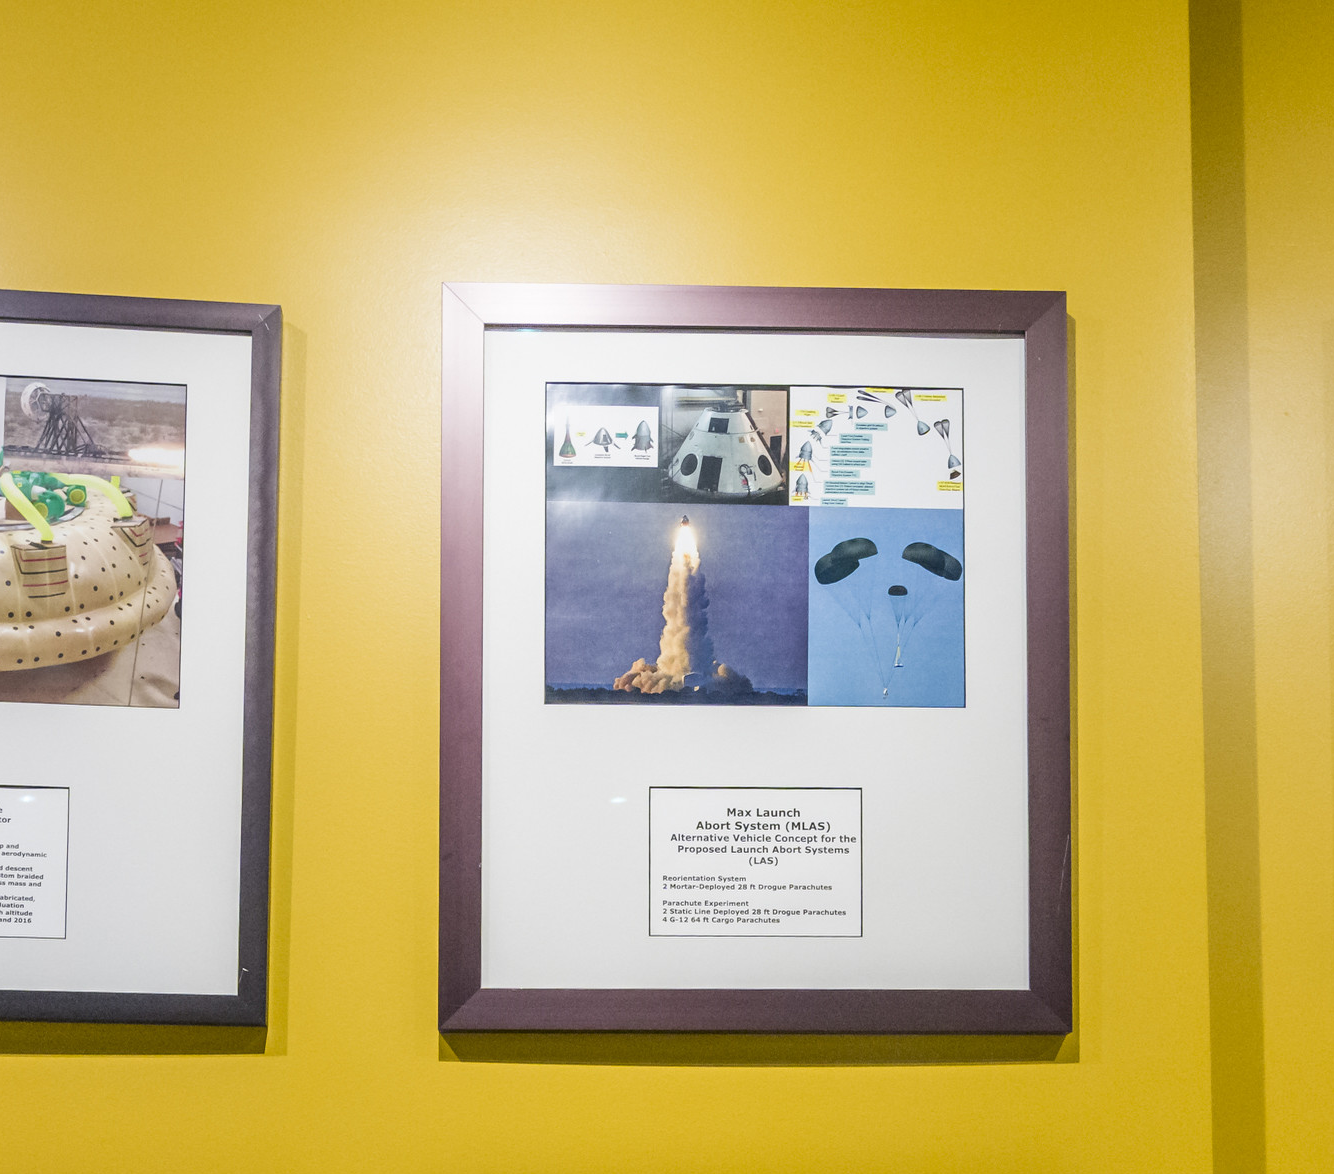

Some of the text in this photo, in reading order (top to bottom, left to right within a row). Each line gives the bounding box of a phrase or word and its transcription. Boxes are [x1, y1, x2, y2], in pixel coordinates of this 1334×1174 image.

[727, 807, 800, 817] Max Launch
[696, 820, 830, 833] Abort System (MLAS)
[670, 833, 856, 844] Alternative Vehicle Concept for the
[677, 845, 849, 855] Proposed Launch Abort Systems
[748, 856, 778, 866] (LAS)
[717, 875, 746, 883] System
[669, 883, 735, 891] Mortar-Deployed
[713, 908, 749, 916] Deployed
[772, 908, 800, 917] Drogue
[711, 916, 734, 924] Cargo
